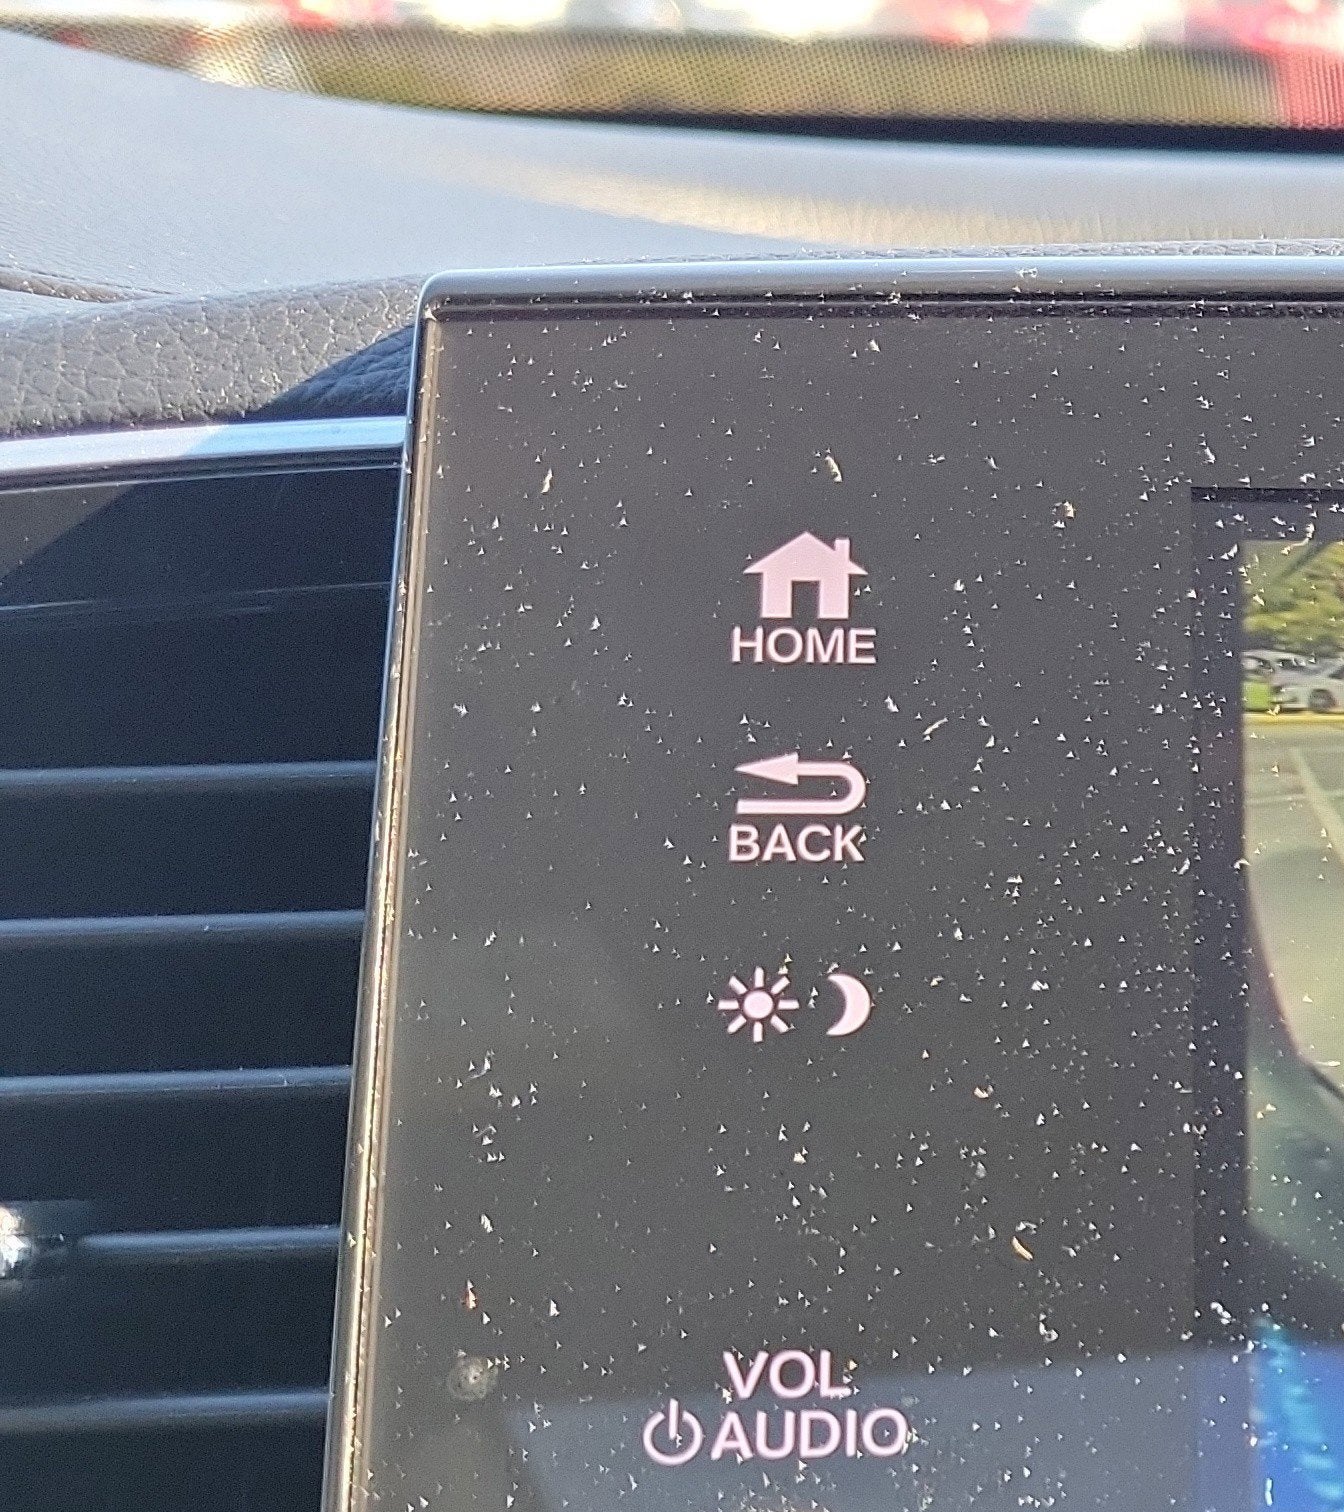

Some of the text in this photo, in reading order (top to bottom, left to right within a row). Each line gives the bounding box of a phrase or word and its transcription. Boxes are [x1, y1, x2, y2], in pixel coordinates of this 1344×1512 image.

[730, 625, 878, 664] HOME
[728, 822, 865, 862] BACK
[722, 1349, 852, 1399] VOL
[710, 1408, 908, 1460] AUDIO
